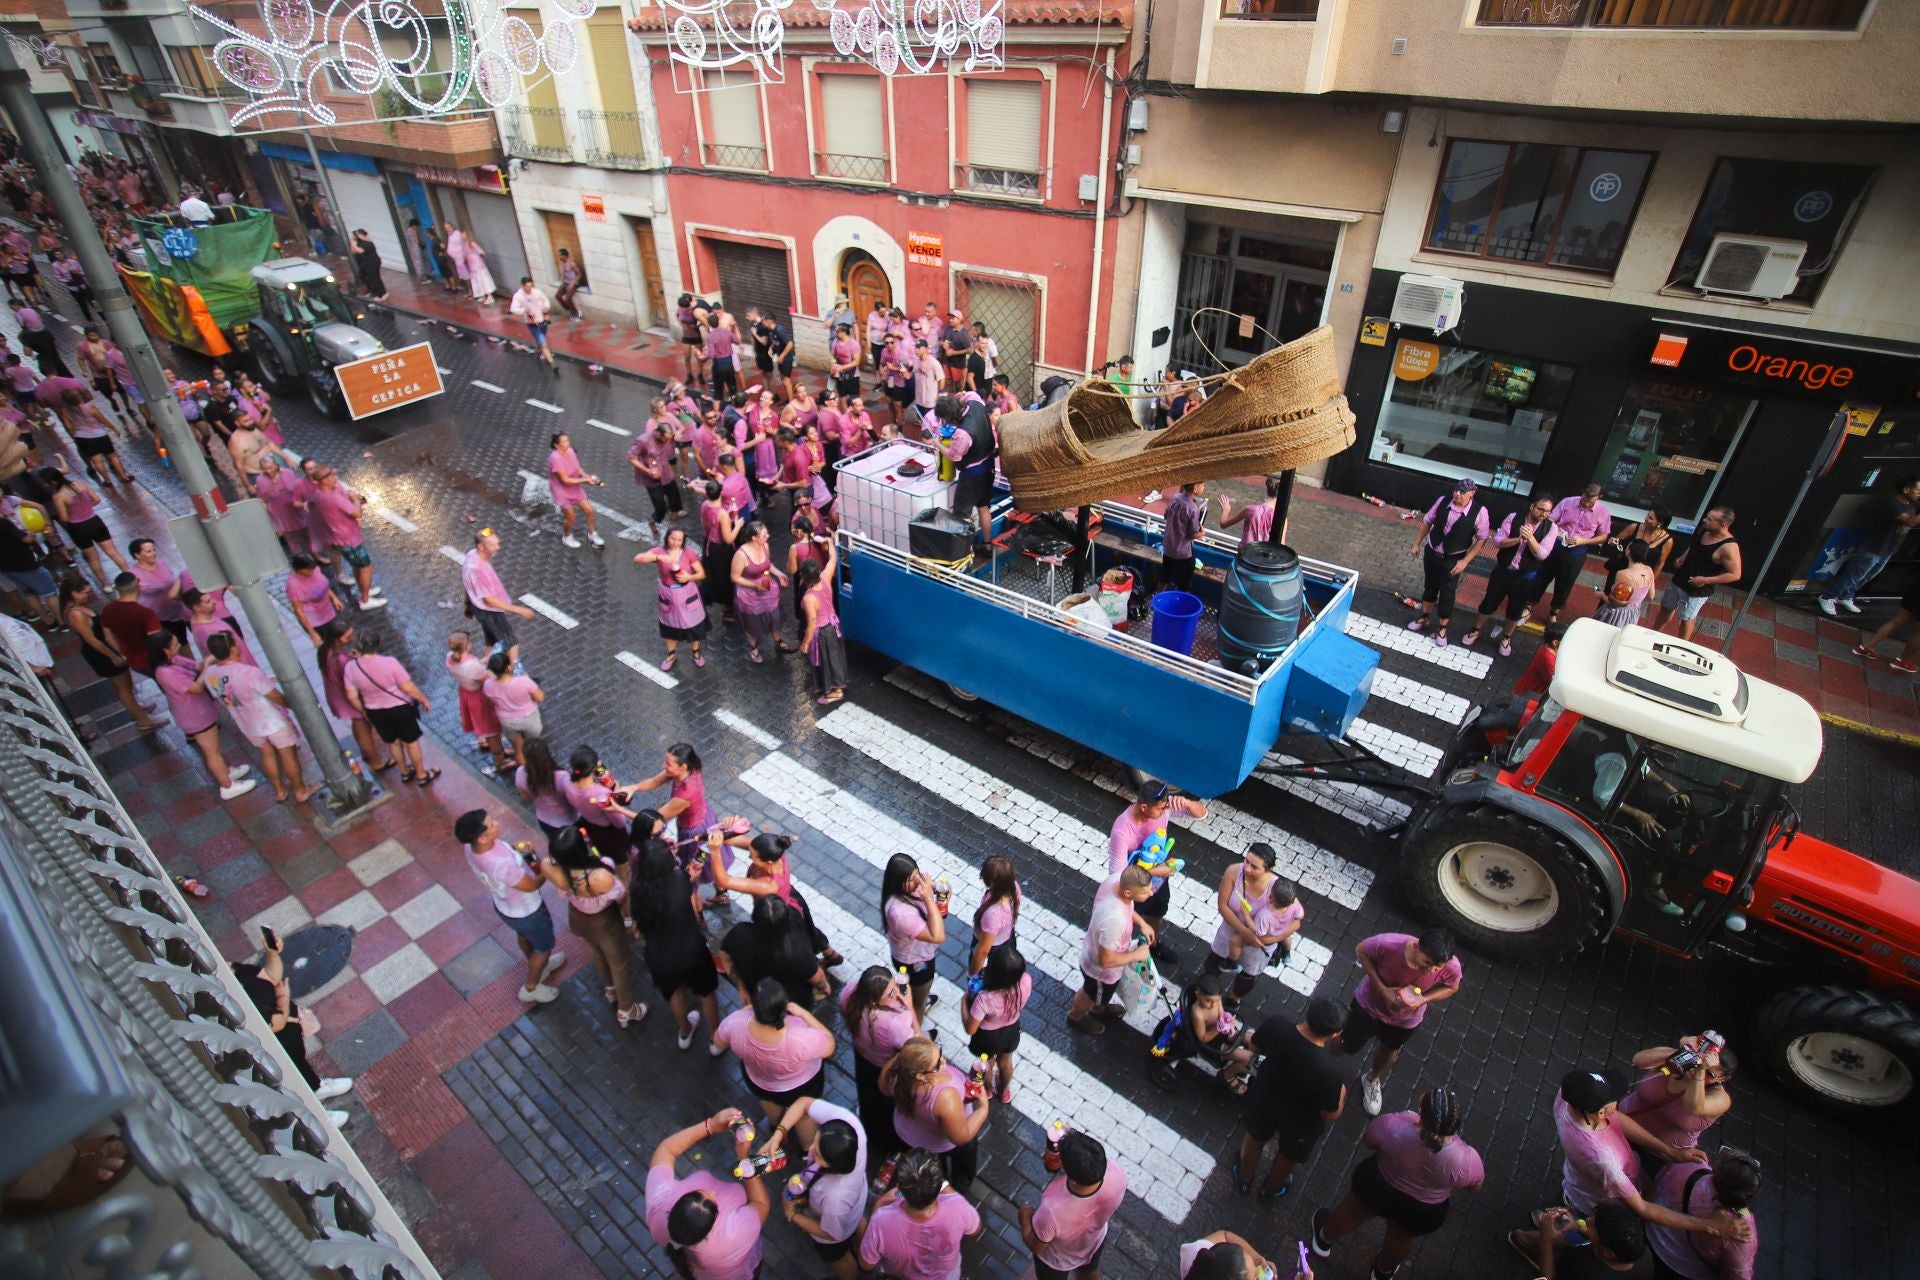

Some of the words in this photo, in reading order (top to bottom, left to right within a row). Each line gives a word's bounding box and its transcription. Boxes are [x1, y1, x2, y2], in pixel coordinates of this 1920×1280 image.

[909, 244, 942, 258] VENDE
[1403, 345, 1432, 359] Fibra
[371, 358, 406, 375] PEÑA
[1401, 355, 1429, 367] 1Gbps
[1651, 357, 1677, 366] orange
[1727, 346, 1855, 390] Orange
[382, 371, 401, 384] LA
